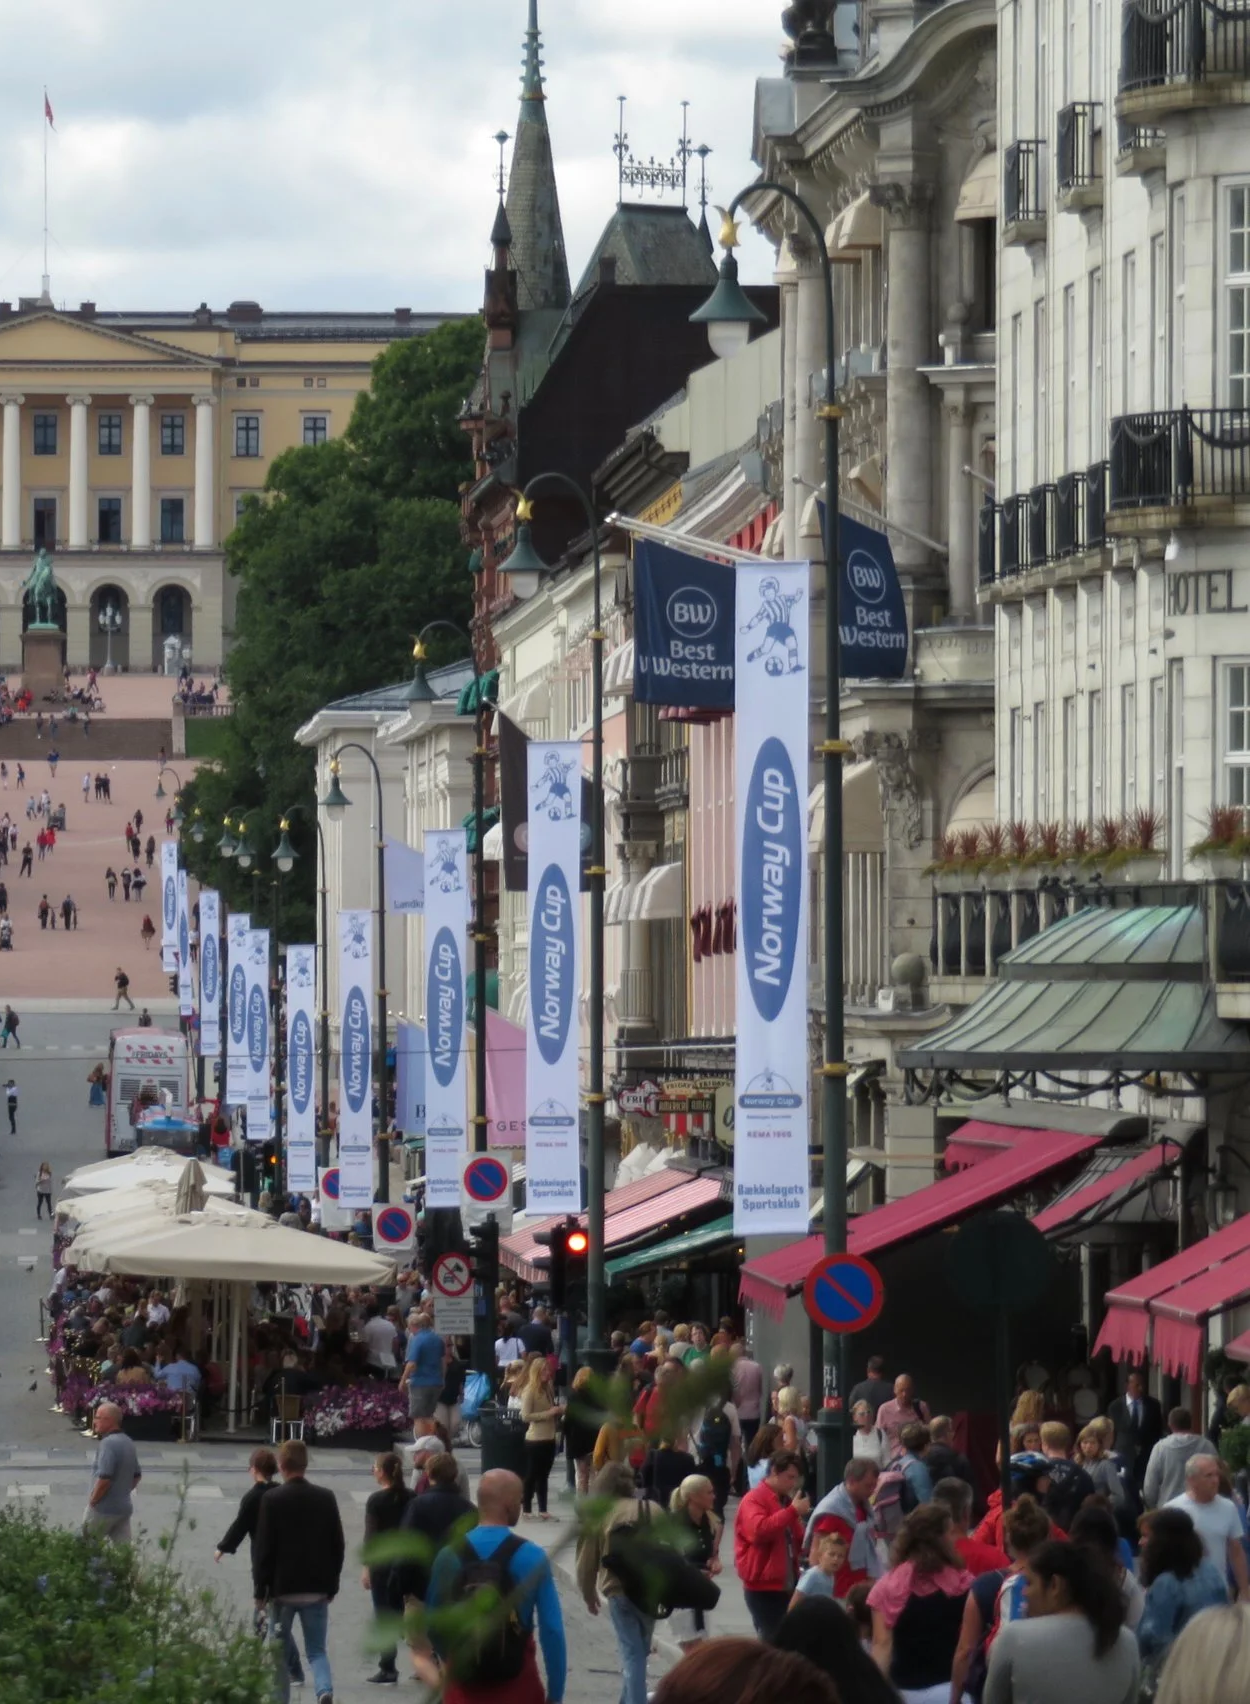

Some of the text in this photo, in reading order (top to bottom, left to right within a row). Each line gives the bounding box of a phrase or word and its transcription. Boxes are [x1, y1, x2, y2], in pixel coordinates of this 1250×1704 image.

[853, 566, 882, 589] BW
[1165, 568, 1248, 616] HOTEL
[674, 603, 712, 624] BW
[855, 606, 892, 628] Best
[838, 625, 906, 649] Western
[670, 641, 716, 661] Best
[652, 656, 734, 680] Western
[754, 767, 791, 986] Norway Cup
[539, 884, 566, 1040] Norway Cup
[233, 972, 244, 1034] Norway Cup
[251, 992, 262, 1012] Cup
[434, 943, 456, 1067] Norway Cup
[348, 999, 365, 1097] Norway Cup
[294, 1020, 308, 1101] Norway Cup
[744, 1097, 795, 1107] Norway Cup
[737, 1183, 804, 1197] Bækkelagets
[742, 1198, 801, 1212] Sportsklub
